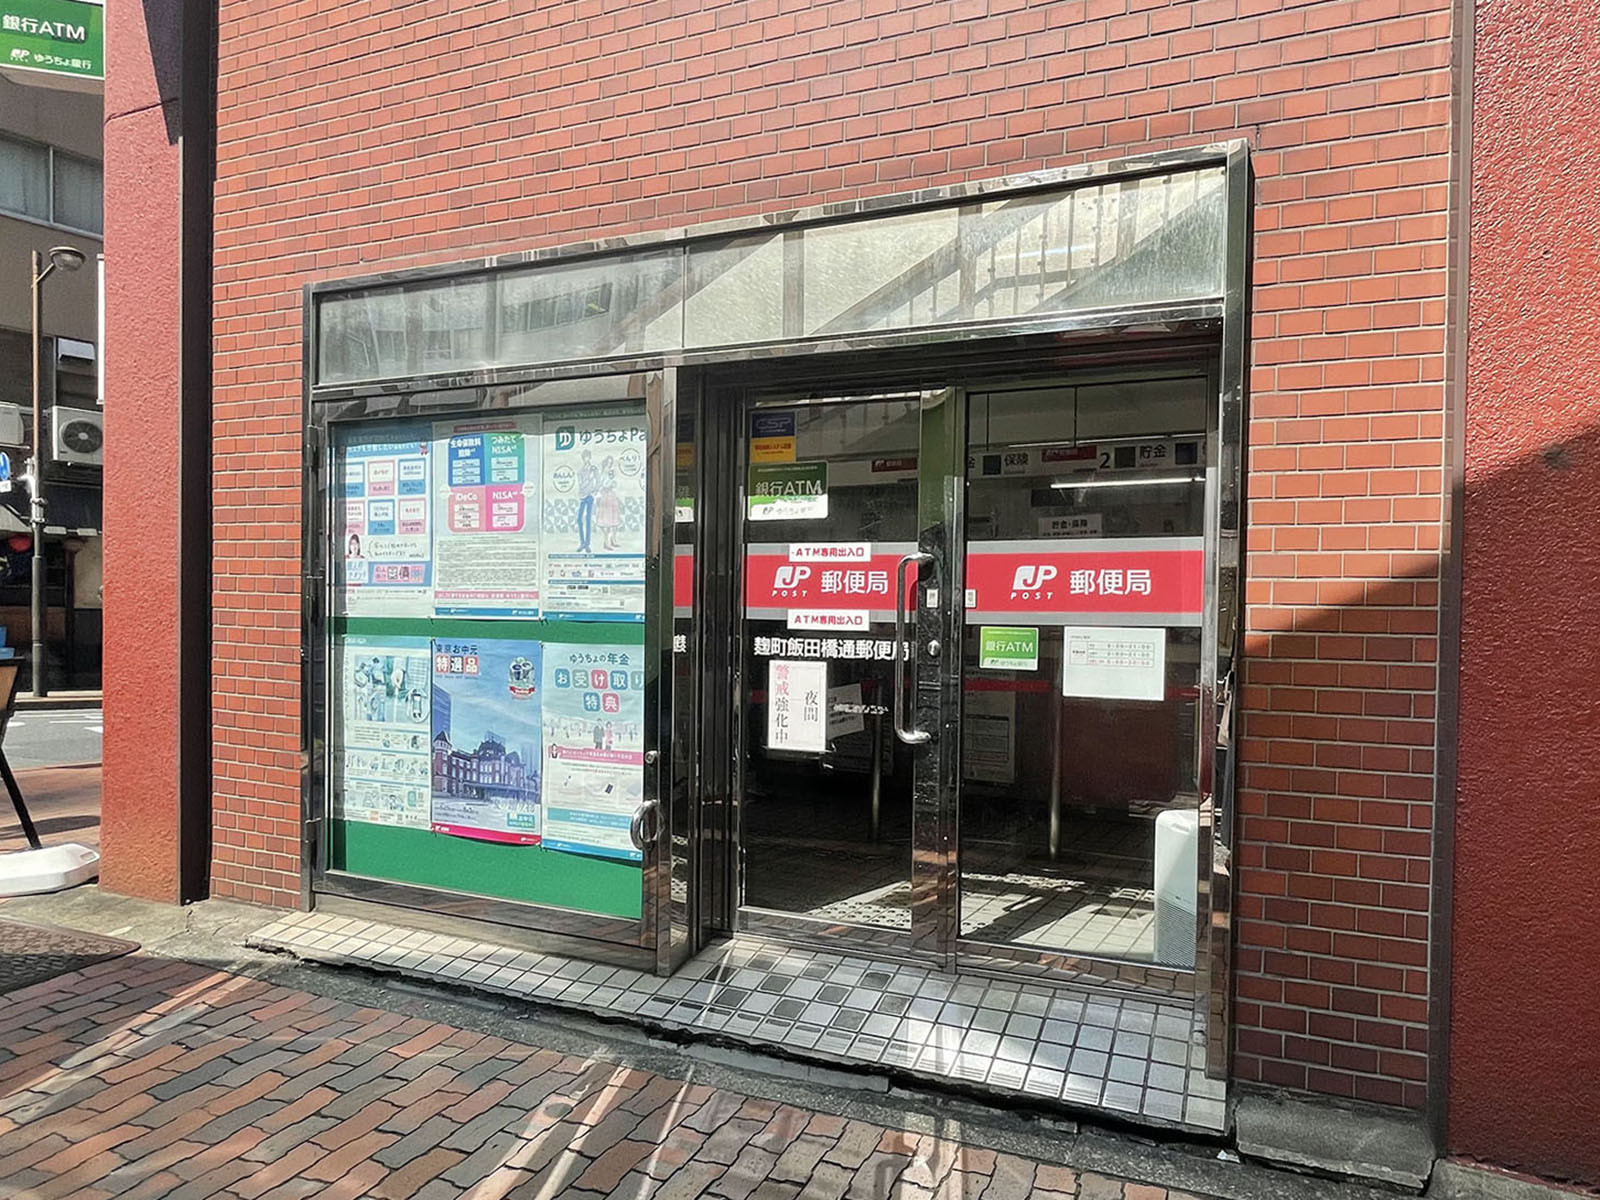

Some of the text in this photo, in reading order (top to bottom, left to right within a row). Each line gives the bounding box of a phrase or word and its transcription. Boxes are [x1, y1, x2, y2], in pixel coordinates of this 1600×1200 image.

[3, 14, 86, 41] 銀行ATM
[34, 53, 92, 69] ゆうちょ銀行
[1139, 443, 1167, 460] 貯金
[1100, 452, 1111, 469] 2
[756, 479, 823, 496] 銀行ATM
[795, 546, 865, 557] ATM専用出入口
[773, 565, 889, 595] JP 郵便局
[1012, 565, 1152, 596] JP 郵便局
[771, 589, 808, 598] POST
[1010, 591, 1054, 600] POST
[794, 614, 863, 625] ATM専用出入口
[753, 636, 910, 660] 麹町飯田橋通郵便局
[985, 640, 1034, 653] 銀行ATM
[436, 655, 478, 673] 特選品
[569, 652, 630, 666] ゆうちょの年金
[585, 694, 617, 711] 特典
[775, 664, 790, 744] 警戒強化中
[803, 690, 819, 722] 夜間
